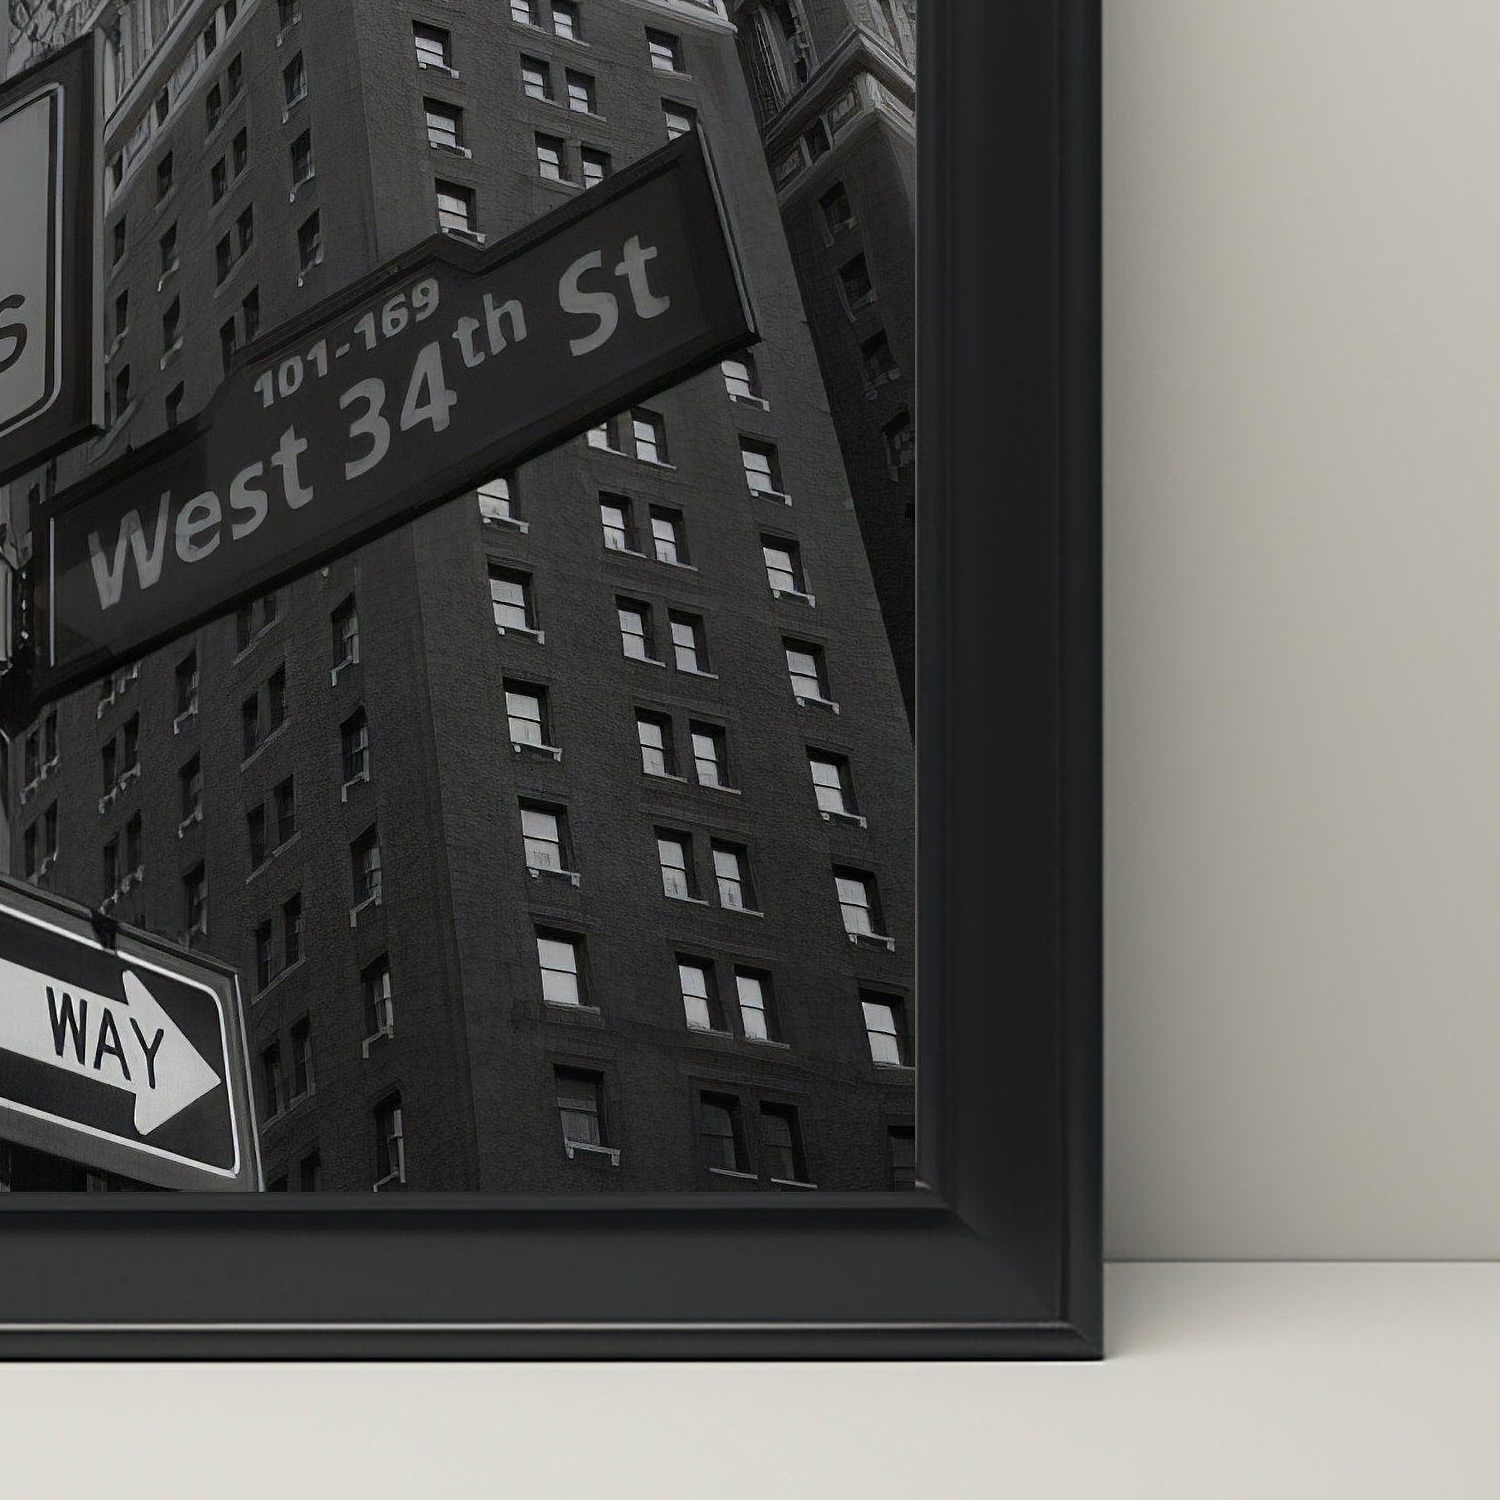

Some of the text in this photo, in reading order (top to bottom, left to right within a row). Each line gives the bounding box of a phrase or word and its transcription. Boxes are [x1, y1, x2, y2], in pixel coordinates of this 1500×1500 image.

[253, 278, 440, 408] 101-169
[87, 235, 670, 611] West 34th St
[45, 985, 165, 1090] WAY
